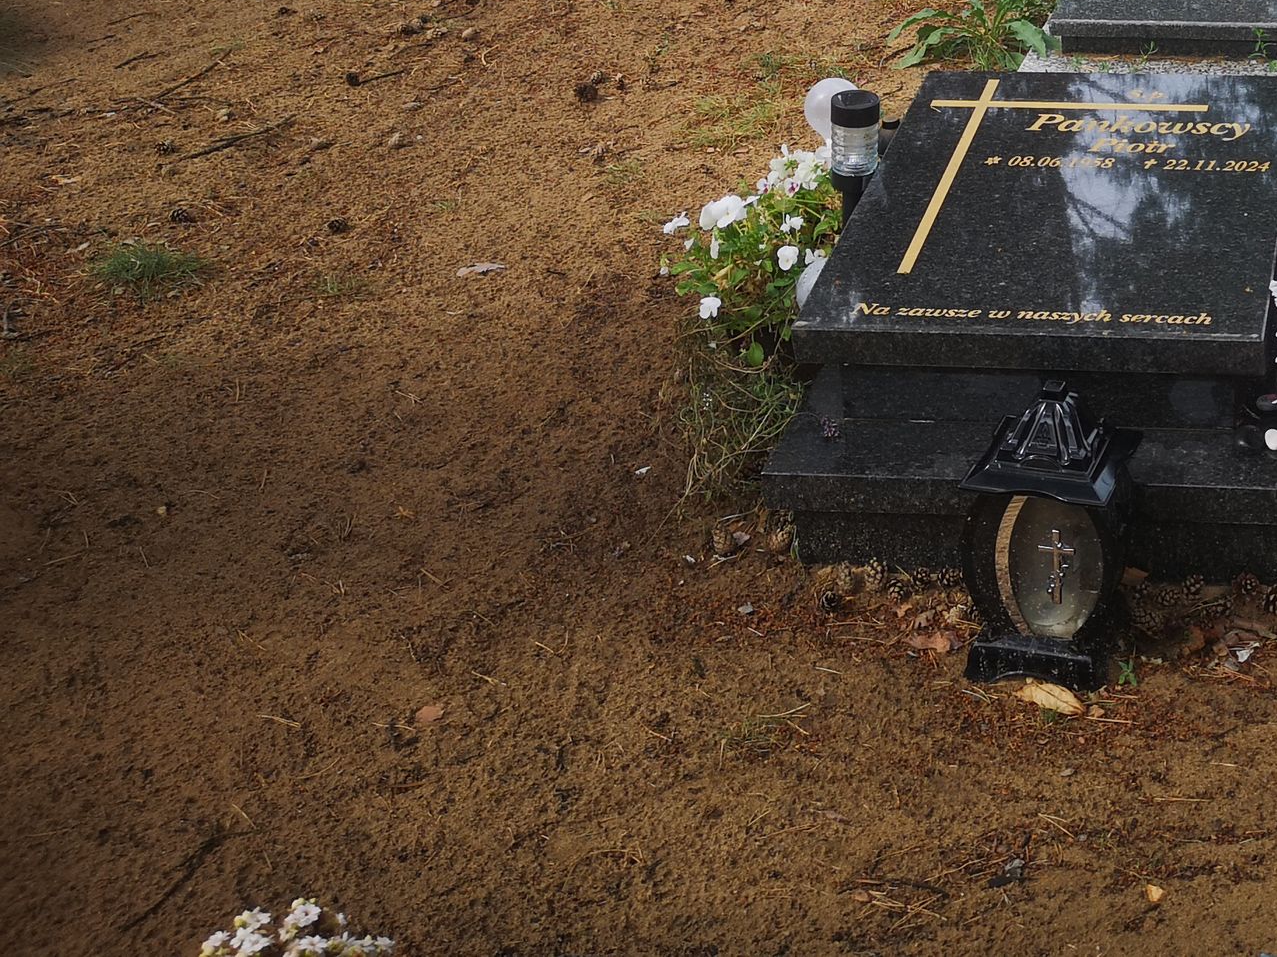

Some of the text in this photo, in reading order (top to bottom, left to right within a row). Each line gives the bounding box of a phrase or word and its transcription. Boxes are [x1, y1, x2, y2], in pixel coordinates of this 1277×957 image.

[1025, 113, 1251, 141] Pankowscy
[1088, 138, 1176, 154] Piotr
[1163, 159, 1271, 172] 22.11.2024
[852, 302, 1213, 325] Na zawsze w naszych sercach
